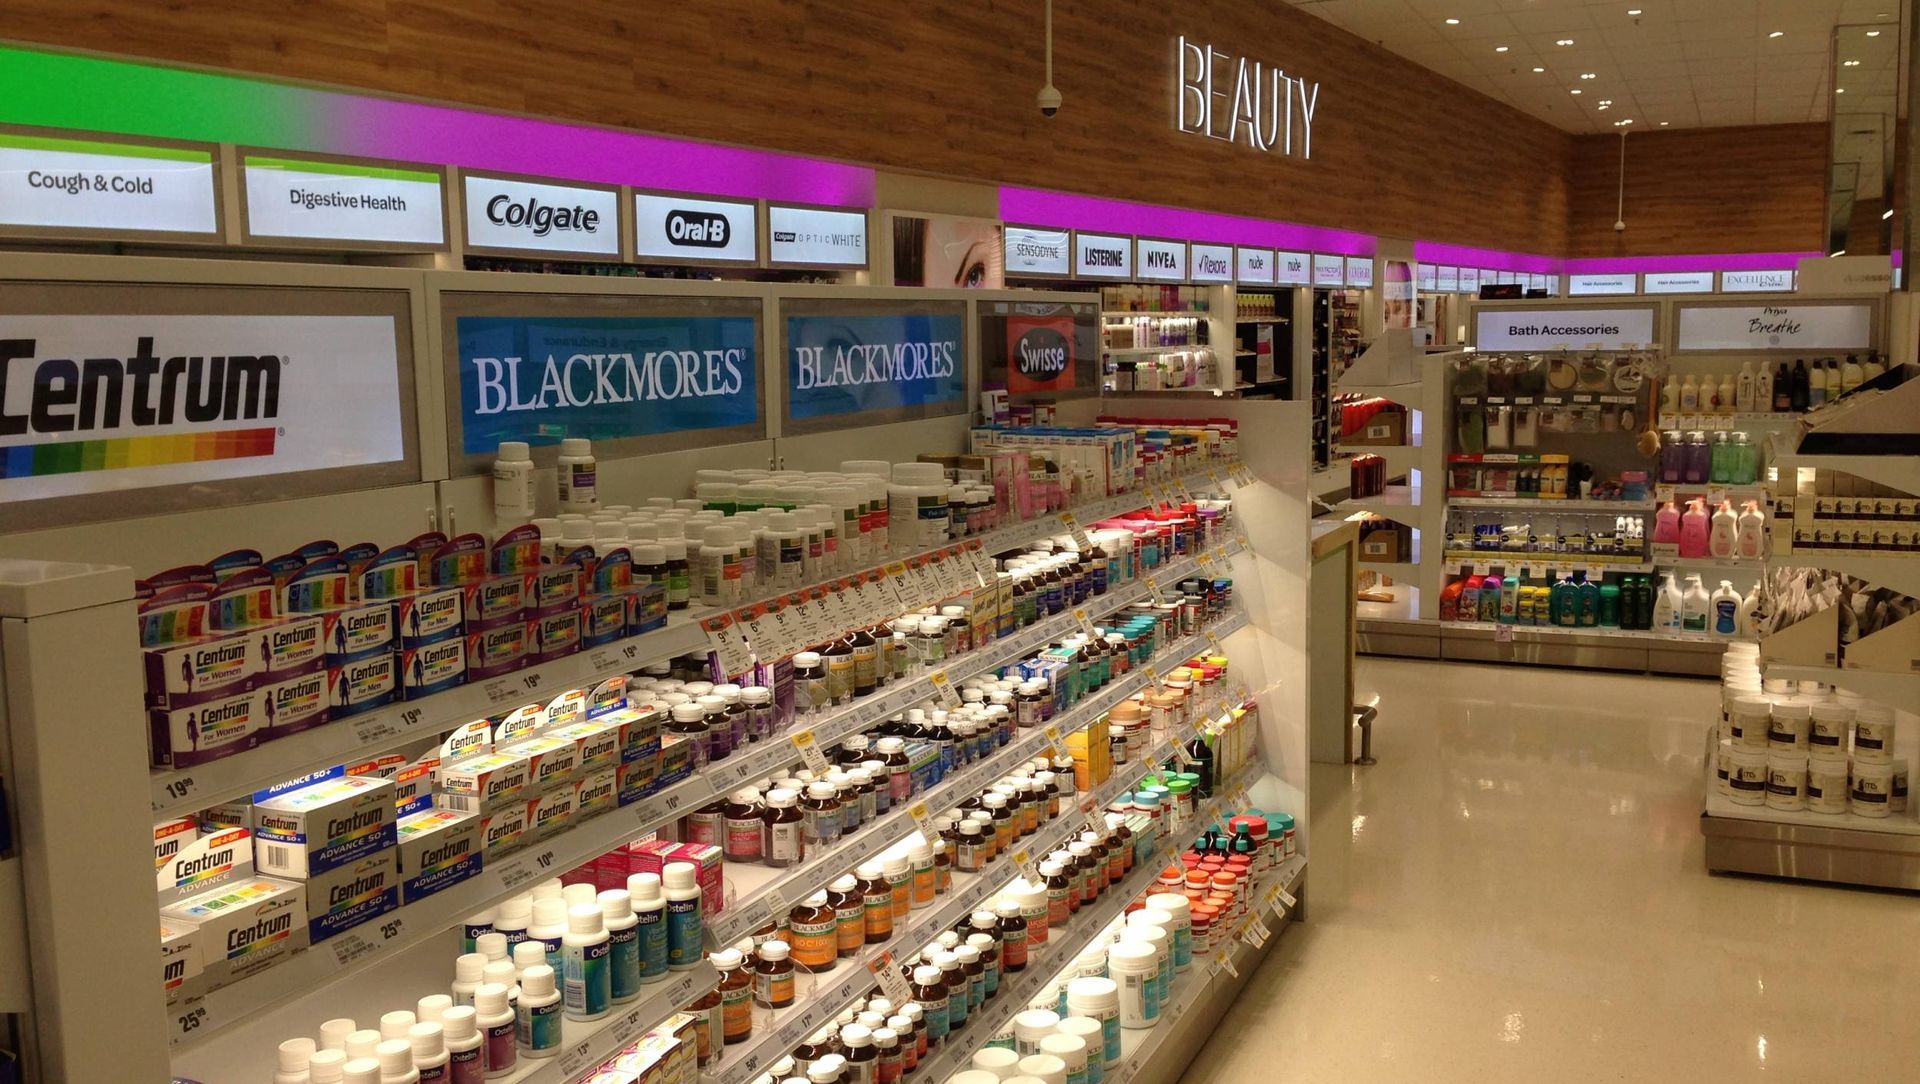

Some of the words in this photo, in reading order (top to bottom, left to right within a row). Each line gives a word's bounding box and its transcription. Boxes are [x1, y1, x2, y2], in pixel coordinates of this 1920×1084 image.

[1179, 35, 1319, 160] BEAUTY
[28, 171, 91, 195] Cough
[93, 176, 108, 193] &
[112, 175, 154, 195] Cold
[290, 189, 358, 211] Digestive
[360, 194, 407, 212] Health
[486, 194, 600, 237] Colgate
[669, 215, 725, 242] Oral-B
[775, 232, 795, 241] Colgate
[798, 233, 830, 244] OPTIC
[831, 233, 861, 248] WHITE
[1016, 243, 1059, 259] SENSODYNE
[1085, 246, 1123, 268] LISTERINE
[1147, 250, 1177, 269] NIVEA
[1204, 255, 1227, 274] Rexona
[1249, 255, 1264, 270] nude
[1288, 258, 1301, 272] nude
[1508, 324, 1539, 336] Bath
[1541, 324, 1620, 336] Accessories
[1748, 318, 1801, 335] Breathe
[796, 341, 954, 390] BLACKMORES
[1021, 338, 1065, 373] Swisse
[472, 347, 743, 415] BLACKMORES
[543, 572, 575, 588] Centrum
[485, 582, 520, 600] Centrum
[421, 597, 455, 615] Centrum
[348, 612, 387, 631] Centrum
[544, 616, 575, 634] Centrum
[273, 627, 317, 648] Centrum
[365, 632, 379, 641] Men
[487, 629, 522, 647] Centrum
[196, 645, 246, 667] Centrum
[287, 648, 314, 660] Women
[425, 645, 459, 665] Centrum
[211, 668, 242, 681] Women
[350, 661, 389, 682] Centrum
[277, 680, 321, 702] Centrum
[368, 682, 382, 692] Men
[594, 688, 620, 704] Centrum
[201, 702, 250, 725] Centrum
[290, 701, 317, 715] Women
[549, 701, 578, 718] Centrum
[216, 724, 246, 738] Women
[504, 717, 536, 734] Centrum
[450, 732, 484, 751] Centrum
[583, 739, 615, 759] Centrum
[540, 755, 574, 777] Centrum
[269, 773, 311, 794] ADVANCE
[313, 768, 333, 780] 50+
[447, 777, 473, 788] Centrum
[488, 773, 524, 796] Centrum
[580, 782, 612, 803] Centrum
[538, 800, 571, 823] Centrum
[261, 815, 298, 831] Centrum
[327, 807, 383, 840] Centrum
[488, 819, 522, 842] Centrum
[257, 832, 284, 841] ADVANCE
[319, 839, 366, 861] ADVANCE
[368, 830, 388, 841] 50+
[420, 838, 470, 869] Centrum
[176, 848, 233, 880] Centrum
[178, 872, 231, 895] ADVANCE
[413, 869, 453, 889] ADVANCE
[456, 860, 474, 872] 50+
[329, 871, 385, 906] Centrum
[320, 902, 366, 928] ADVANCE
[369, 895, 388, 907] 50+
[227, 912, 292, 952] Centrum
